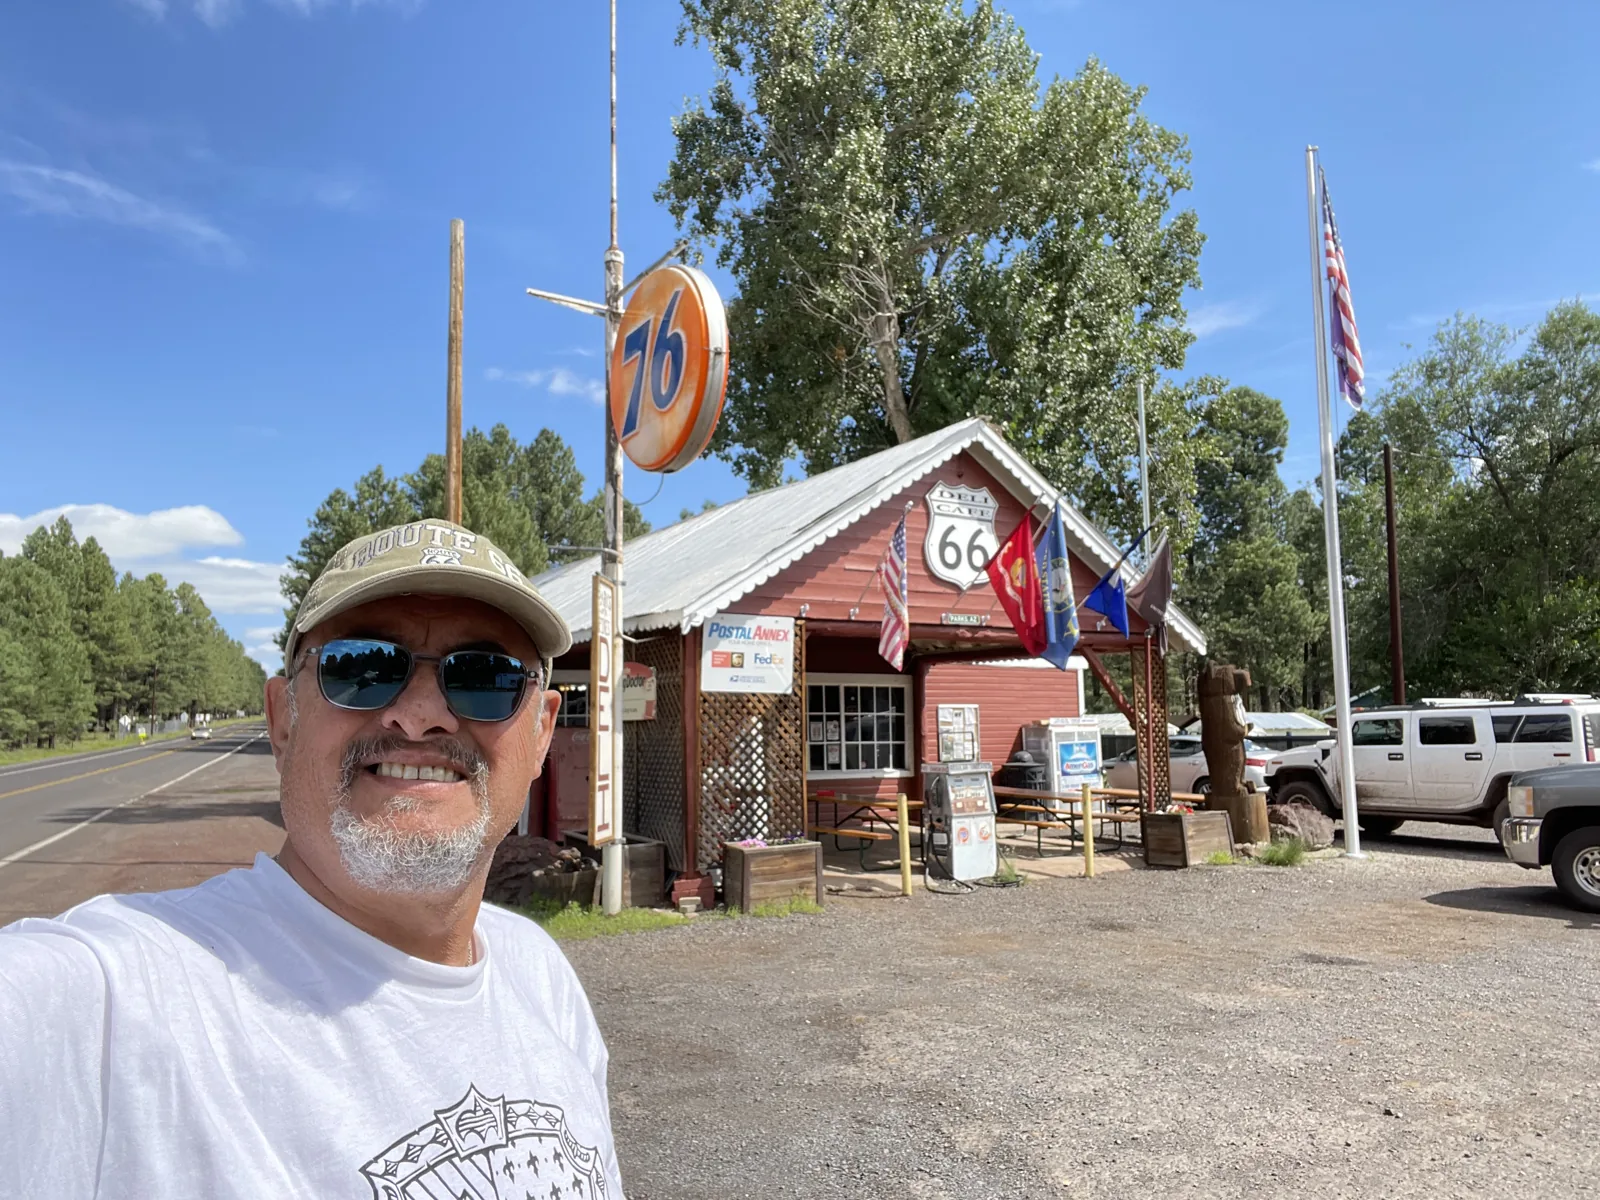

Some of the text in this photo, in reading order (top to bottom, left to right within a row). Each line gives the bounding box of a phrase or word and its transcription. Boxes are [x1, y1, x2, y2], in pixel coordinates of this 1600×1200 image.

[621, 287, 687, 440] 76
[936, 504, 990, 517] CAFE
[938, 490, 988, 504] DELI
[352, 523, 523, 584] ROUTE 66
[938, 524, 989, 573] 66
[754, 653, 785, 664] FedEx
[597, 636, 610, 832] DELI
